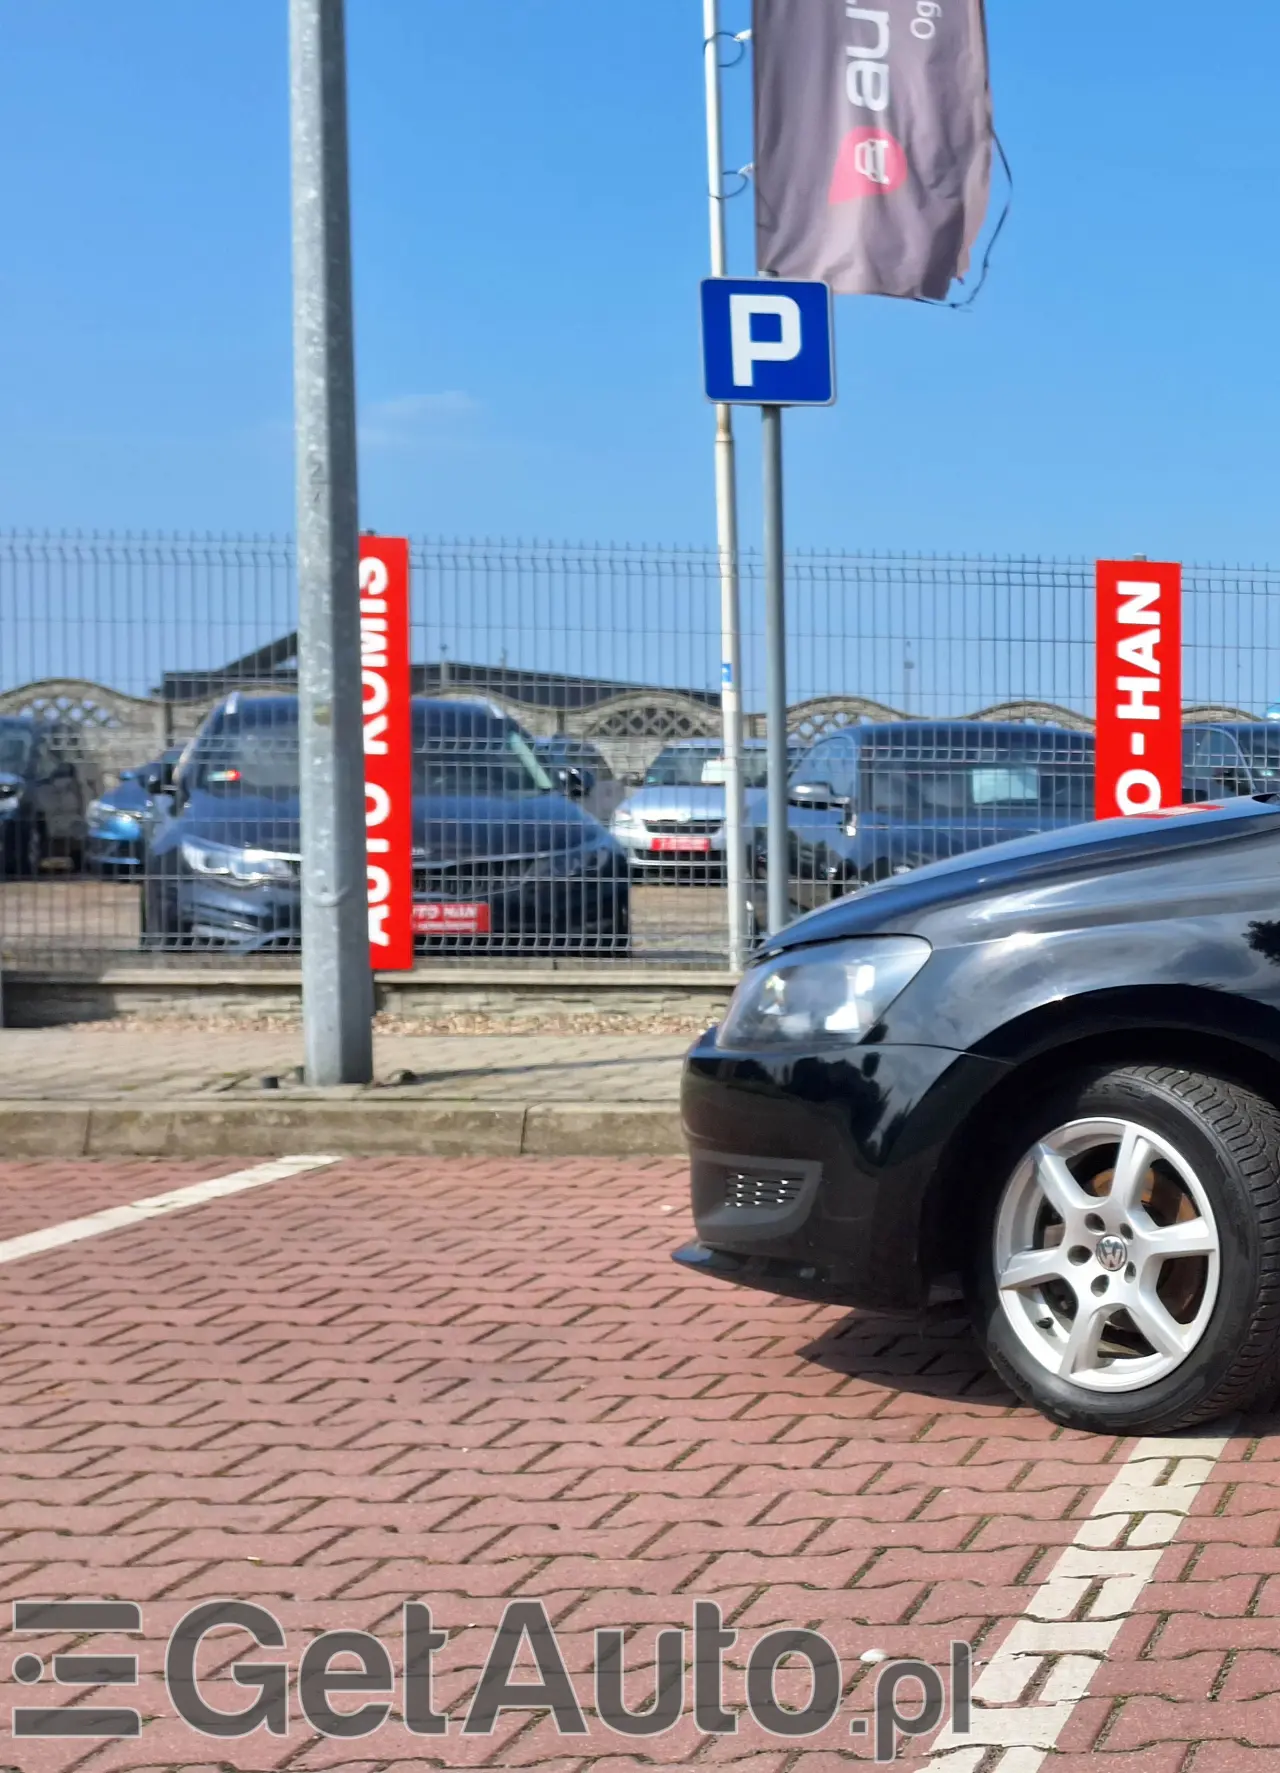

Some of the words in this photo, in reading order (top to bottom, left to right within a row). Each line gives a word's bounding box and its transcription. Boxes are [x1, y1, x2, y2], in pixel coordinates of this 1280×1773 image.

[846, 0, 889, 111] au
[729, 294, 802, 387] P
[1116, 580, 1161, 720] HAN
